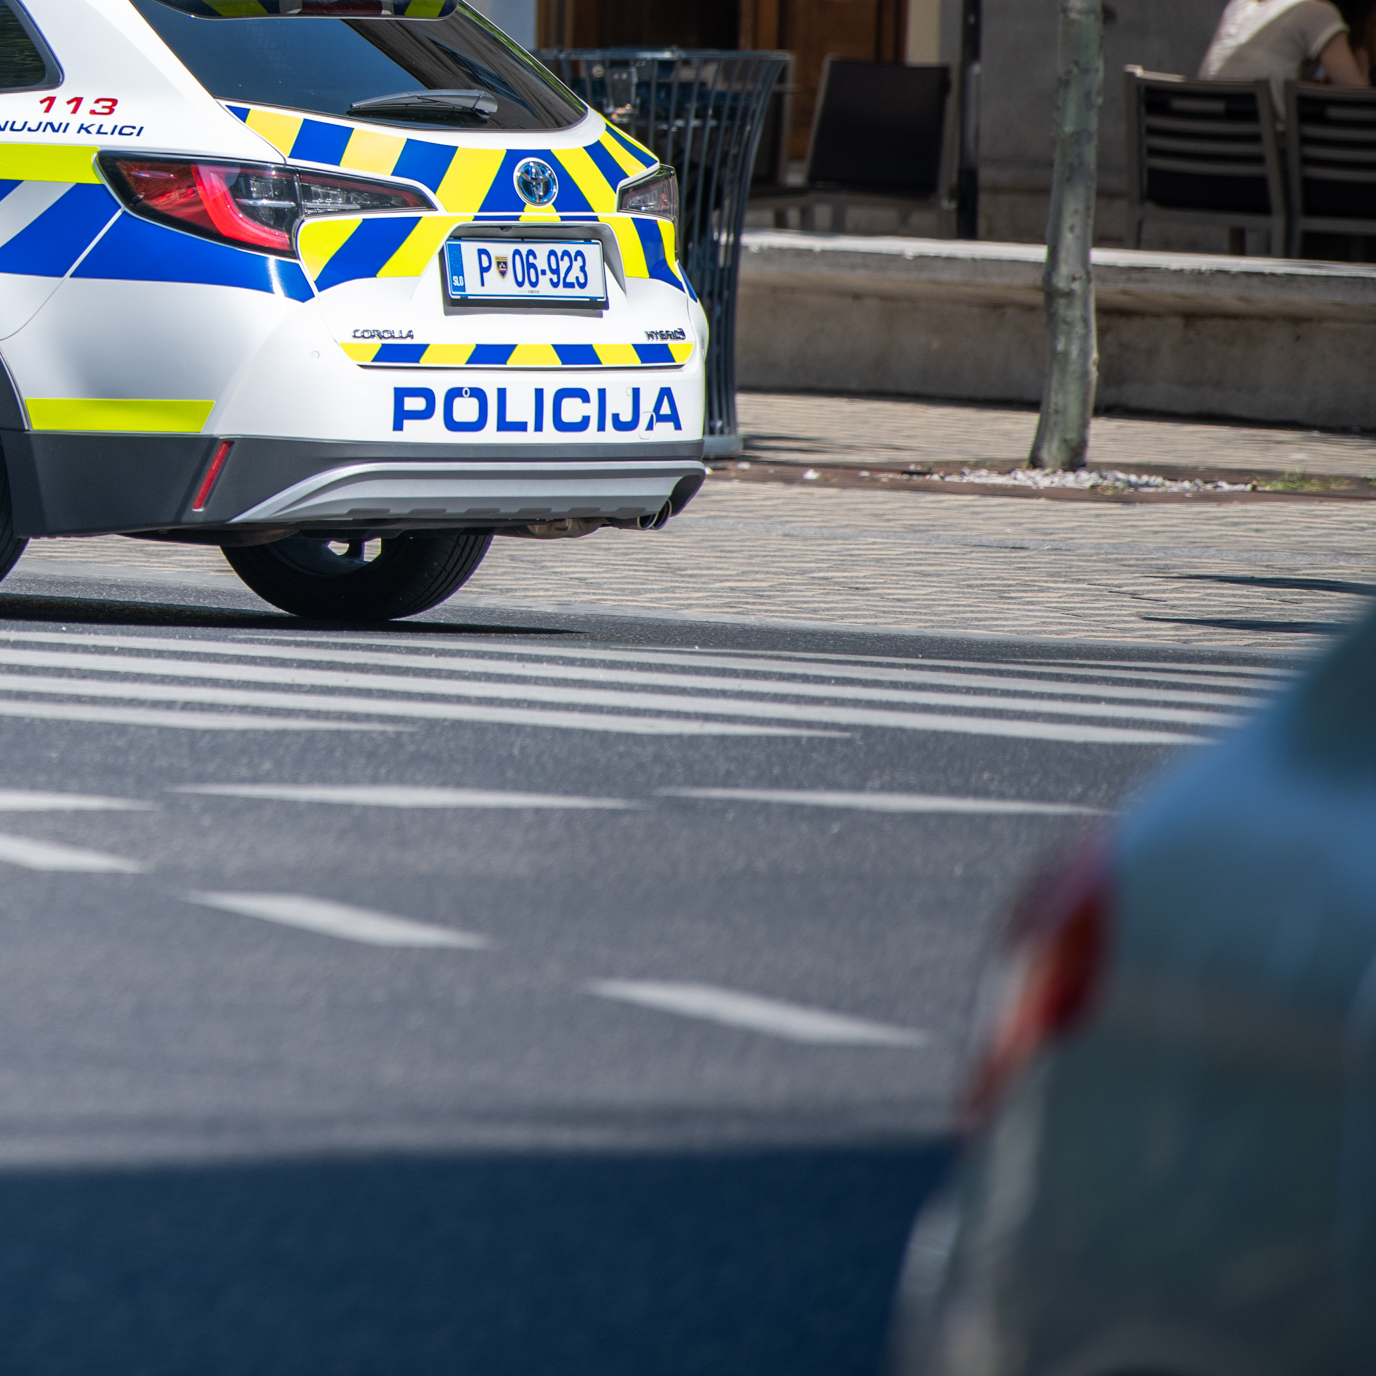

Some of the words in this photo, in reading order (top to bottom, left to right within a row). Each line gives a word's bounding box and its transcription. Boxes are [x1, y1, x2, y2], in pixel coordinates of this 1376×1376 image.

[38, 95, 119, 116] 113
[76, 123, 144, 137] KLICI
[477, 247, 493, 287] P
[511, 248, 589, 290] 06-923
[452, 275, 465, 287] SLO
[351, 328, 415, 340] COROLLA
[392, 386, 683, 433] POLICIJA
